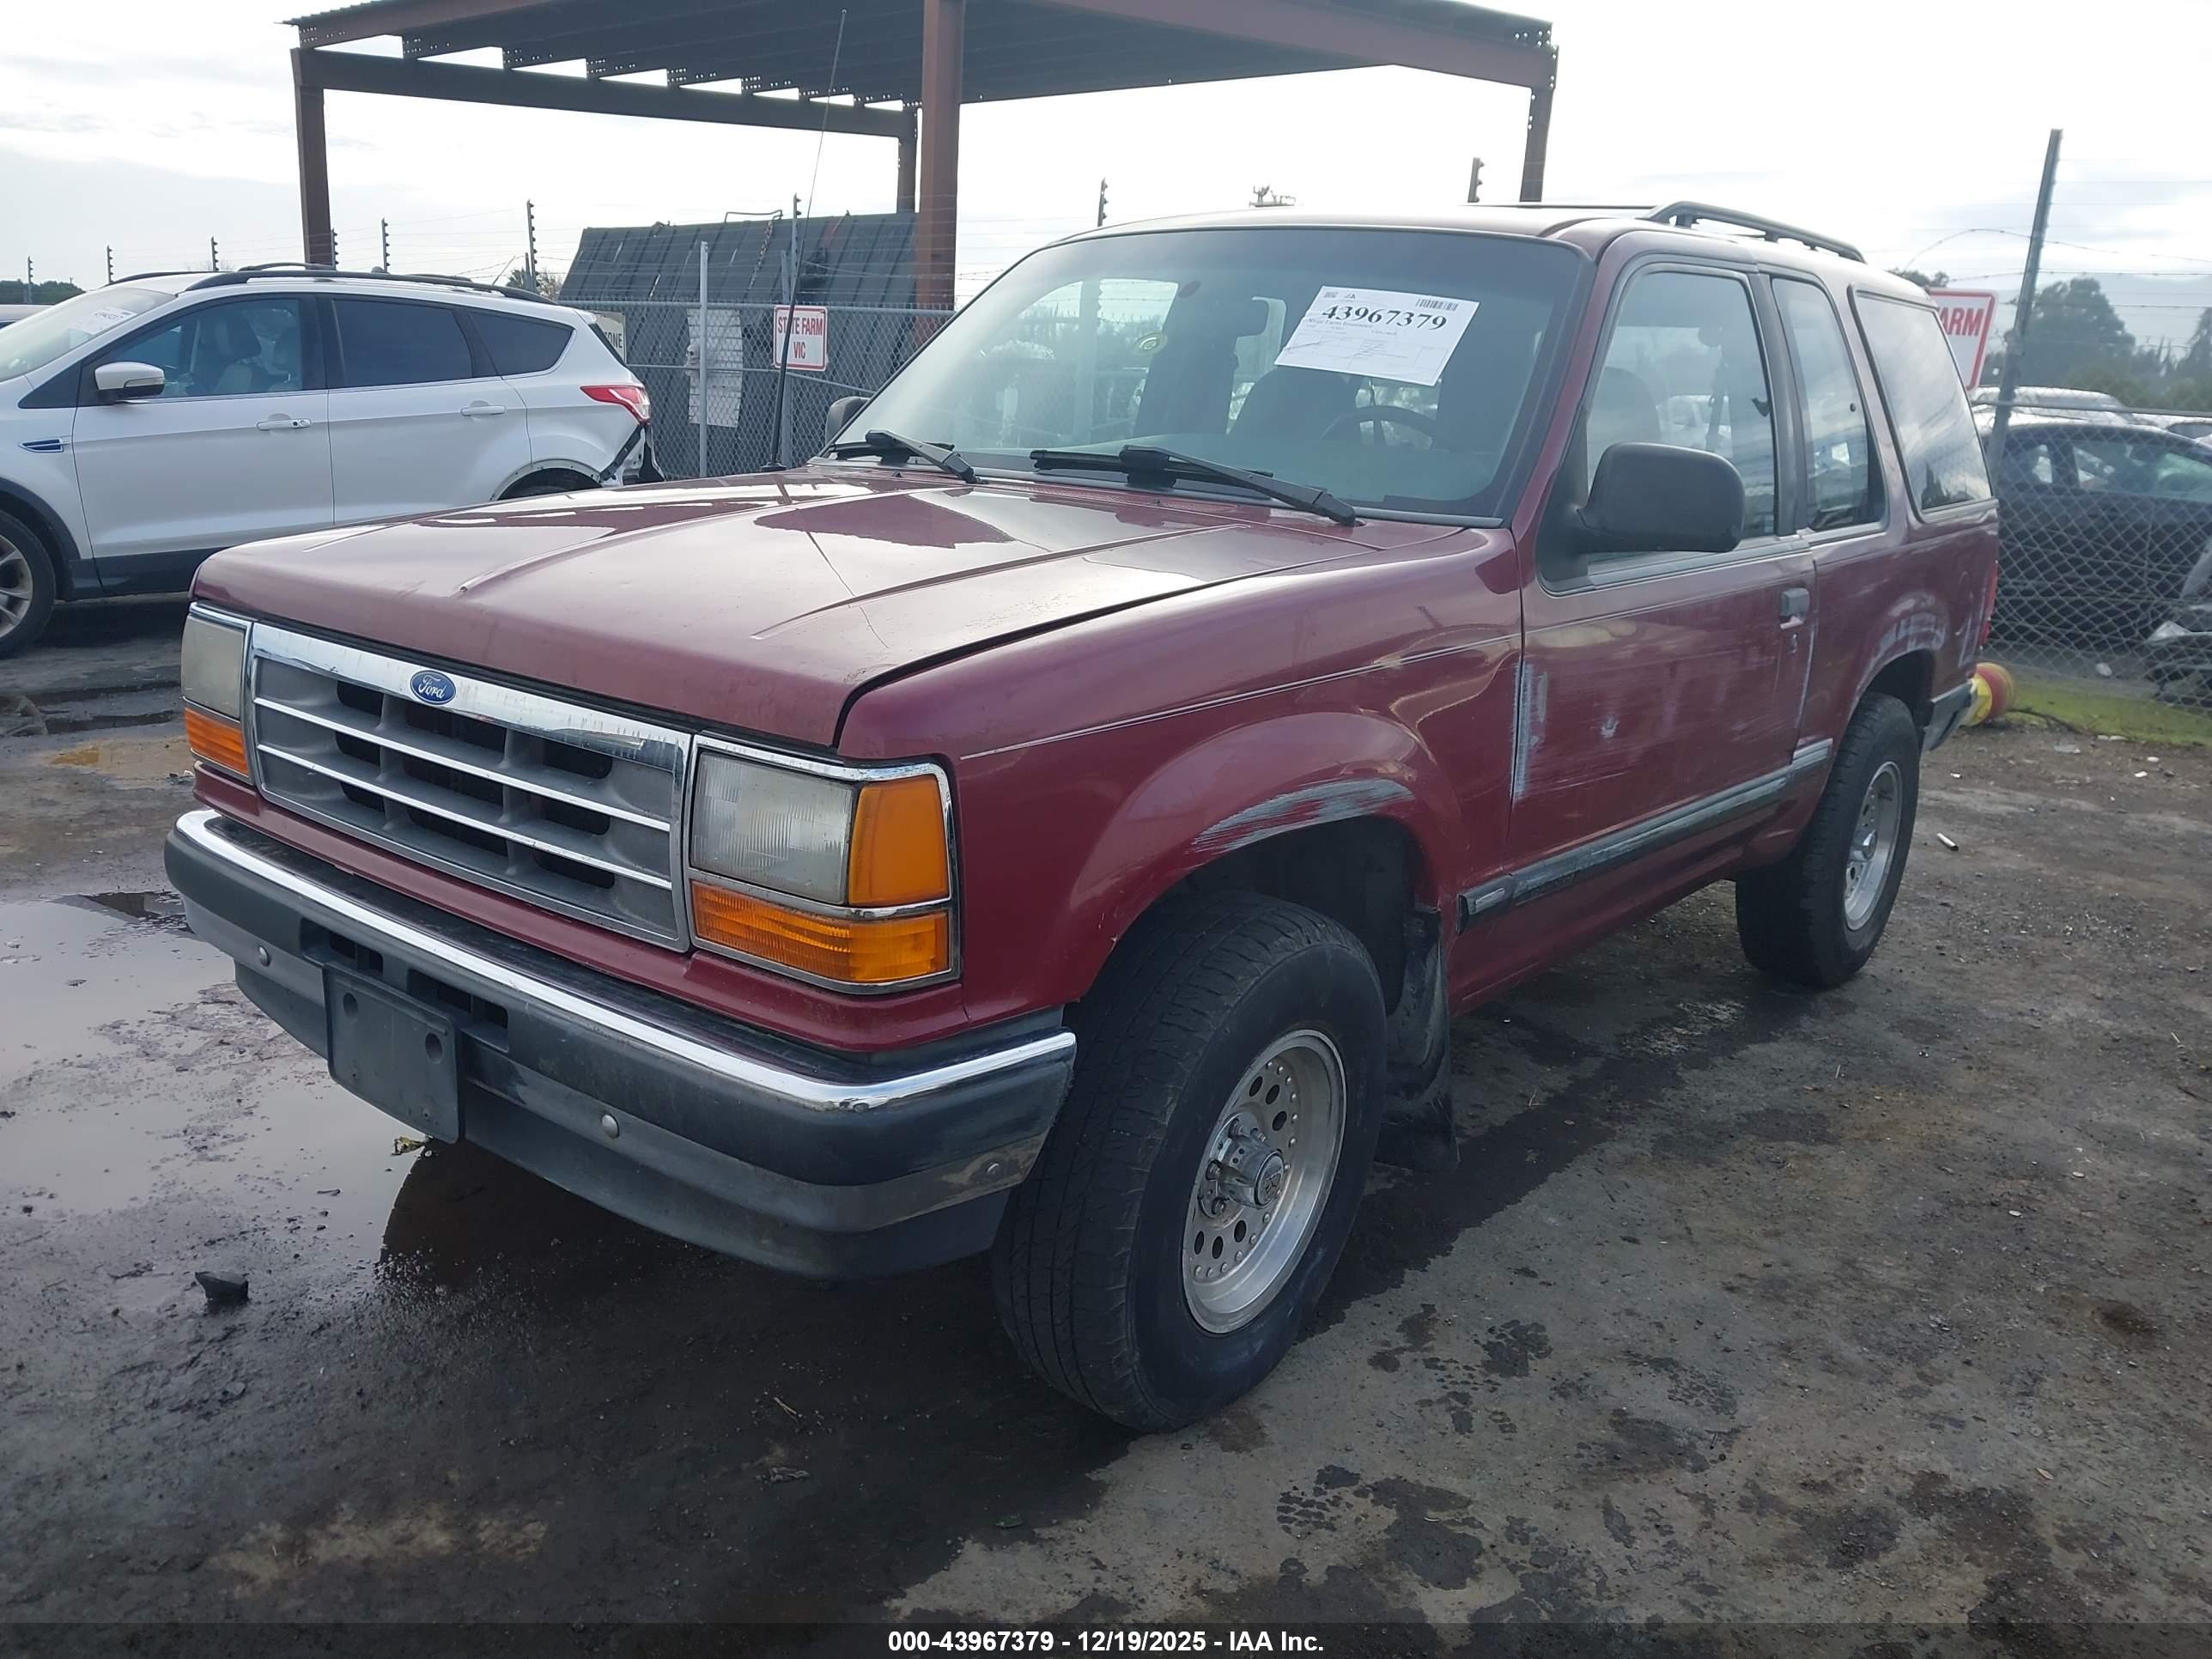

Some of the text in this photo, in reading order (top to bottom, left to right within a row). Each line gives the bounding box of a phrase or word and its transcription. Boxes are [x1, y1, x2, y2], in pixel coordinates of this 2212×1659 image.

[778, 316, 823, 336] STTE FARM
[1322, 305, 1448, 331] 43967379
[1937, 307, 1984, 337] ARM
[793, 342, 805, 359] VIC
[418, 674, 447, 699] Ford
